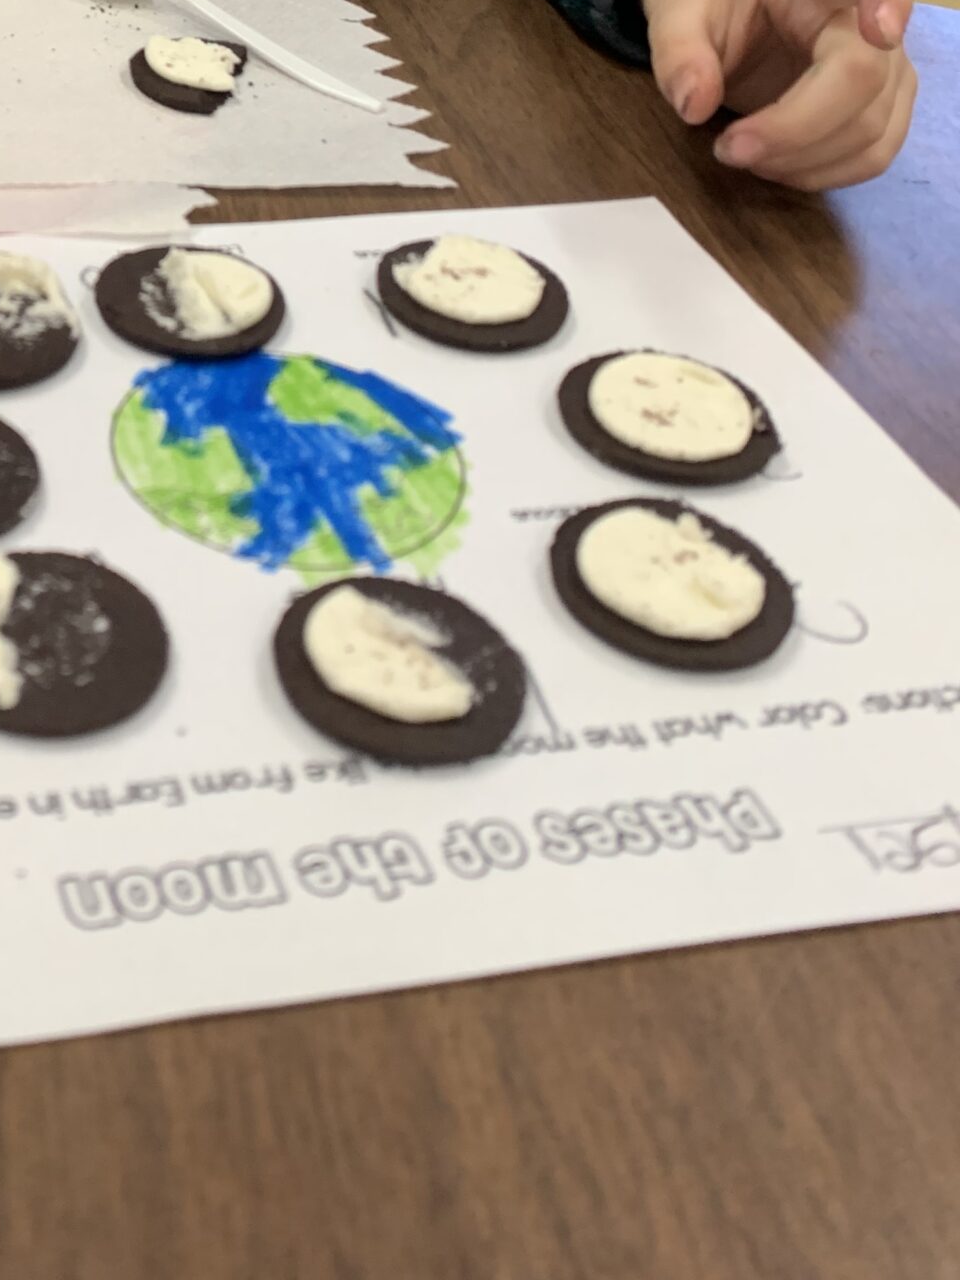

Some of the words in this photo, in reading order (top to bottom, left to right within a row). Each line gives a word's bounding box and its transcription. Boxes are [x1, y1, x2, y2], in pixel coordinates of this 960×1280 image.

[190, 763, 296, 795] from
[28, 787, 64, 820] in
[72, 776, 185, 816] Earth
